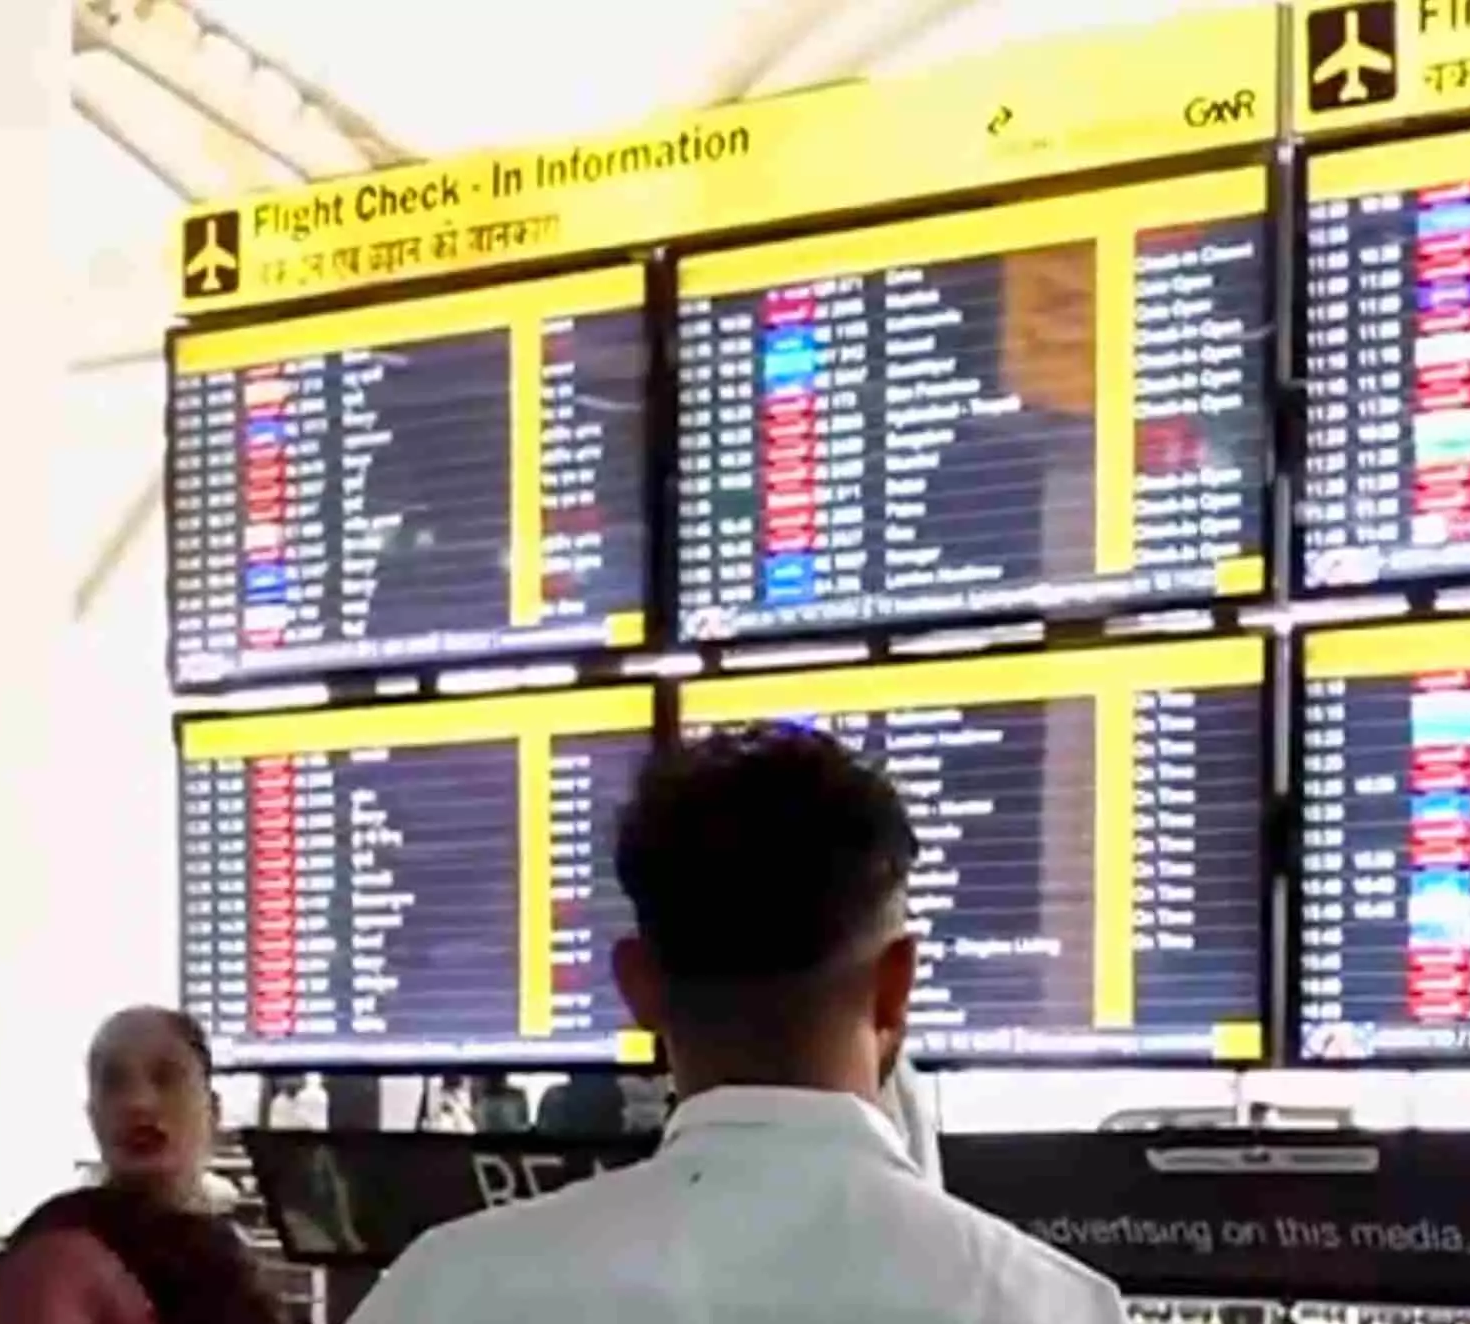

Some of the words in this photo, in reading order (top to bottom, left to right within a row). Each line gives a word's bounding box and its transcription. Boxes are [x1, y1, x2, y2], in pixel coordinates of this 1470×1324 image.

[1183, 89, 1256, 127] GMR
[254, 196, 344, 243] Flight
[354, 176, 461, 223] Check
[491, 162, 523, 198] In
[535, 123, 751, 190] Information
[1030, 1214, 1213, 1254] advertising
[1223, 1218, 1267, 1247] on
[1275, 1215, 1341, 1249] this
